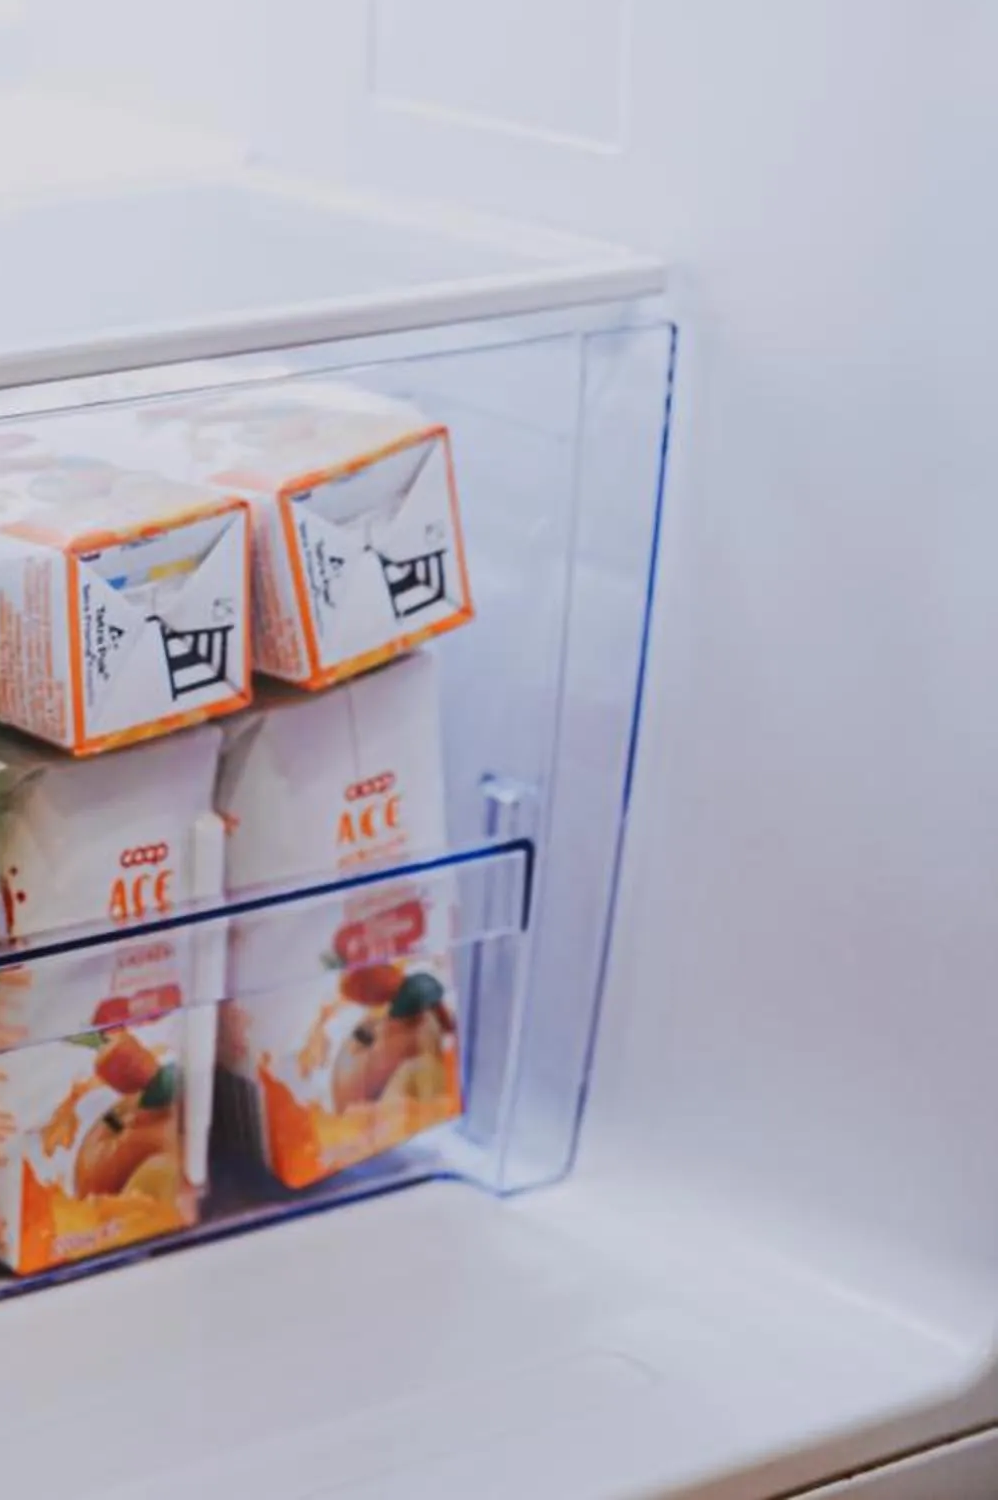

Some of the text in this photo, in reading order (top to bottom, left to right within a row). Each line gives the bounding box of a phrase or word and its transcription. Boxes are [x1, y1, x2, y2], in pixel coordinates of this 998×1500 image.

[337, 795, 401, 844] ACE
[120, 842, 169, 869] coop
[109, 868, 175, 925] ACE
